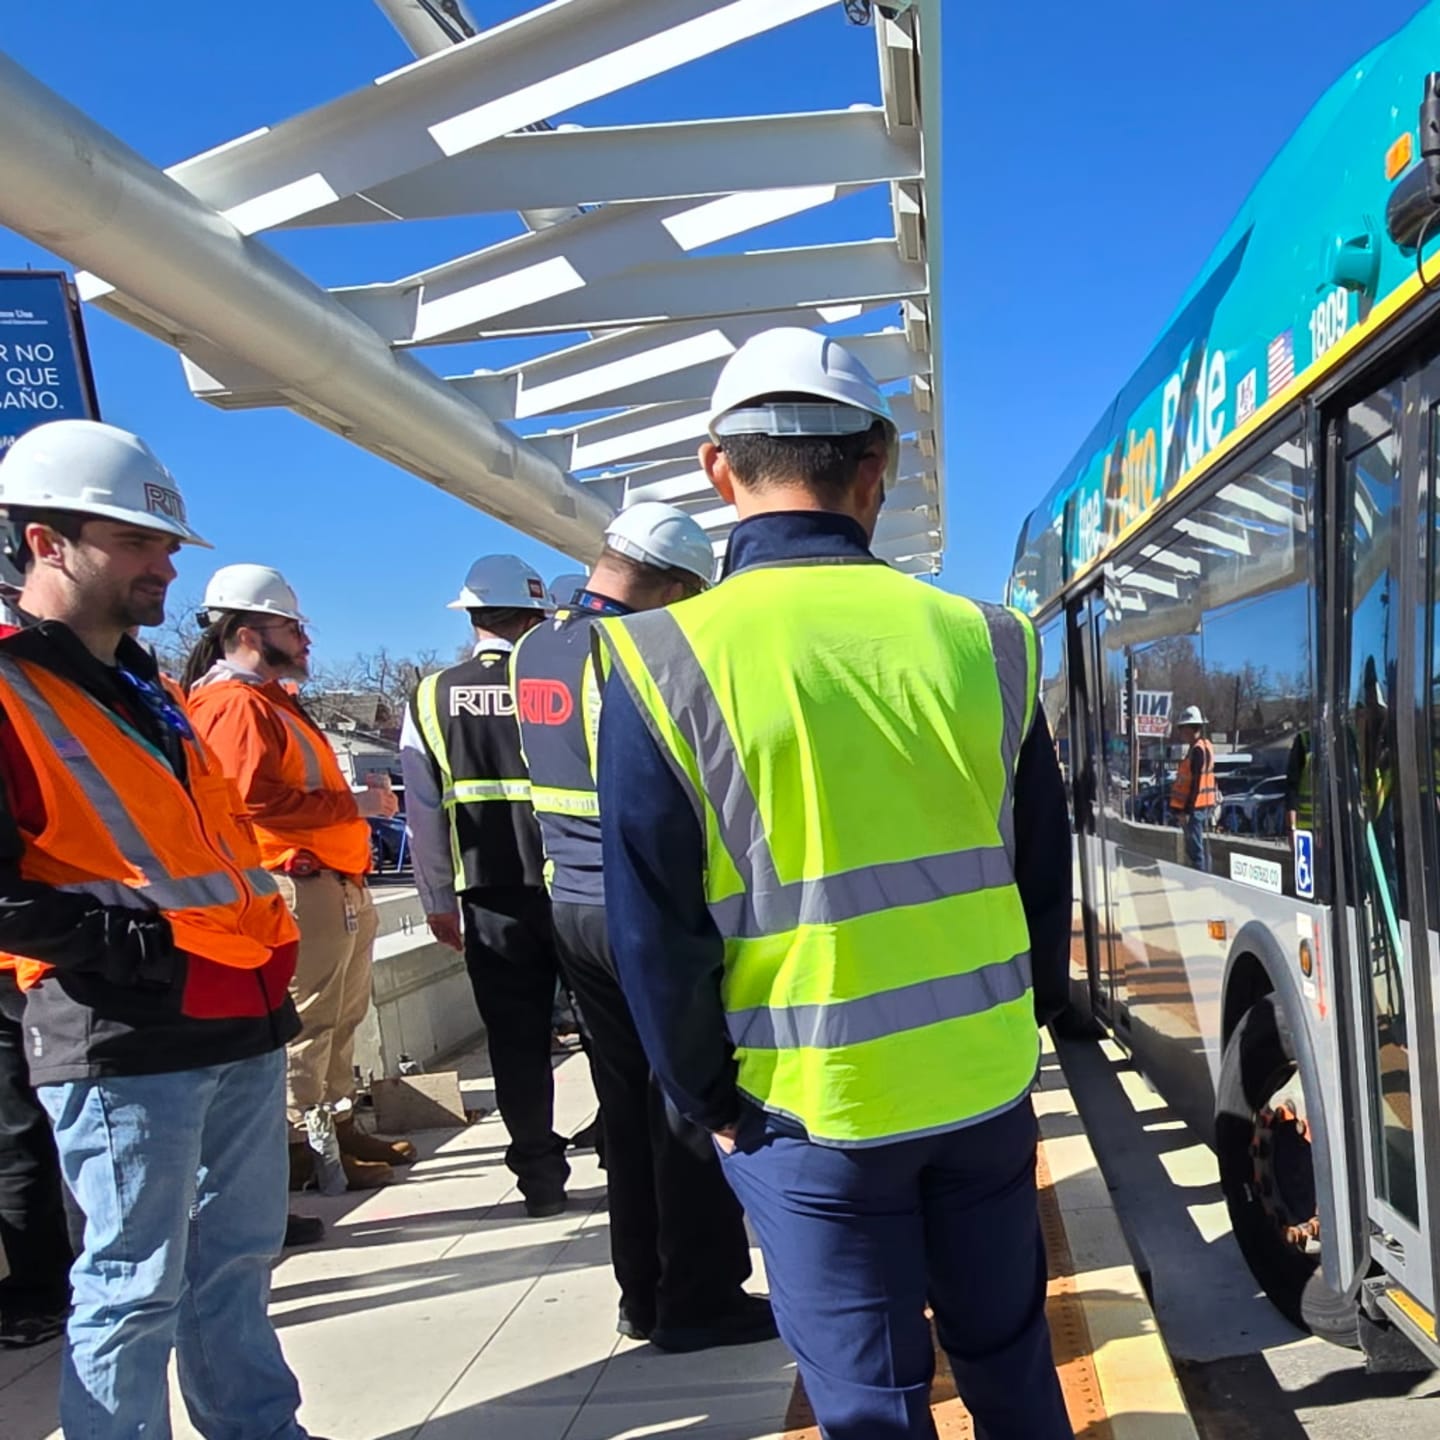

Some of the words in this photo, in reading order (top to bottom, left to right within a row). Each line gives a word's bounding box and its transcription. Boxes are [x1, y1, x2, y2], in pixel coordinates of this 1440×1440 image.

[1309, 286, 1349, 362] 1809
[15, 343, 54, 363] NO
[6, 367, 60, 386] QUE
[0, 386, 65, 410] AÑO.
[450, 684, 516, 717] RTD
[518, 678, 573, 726] RTD
